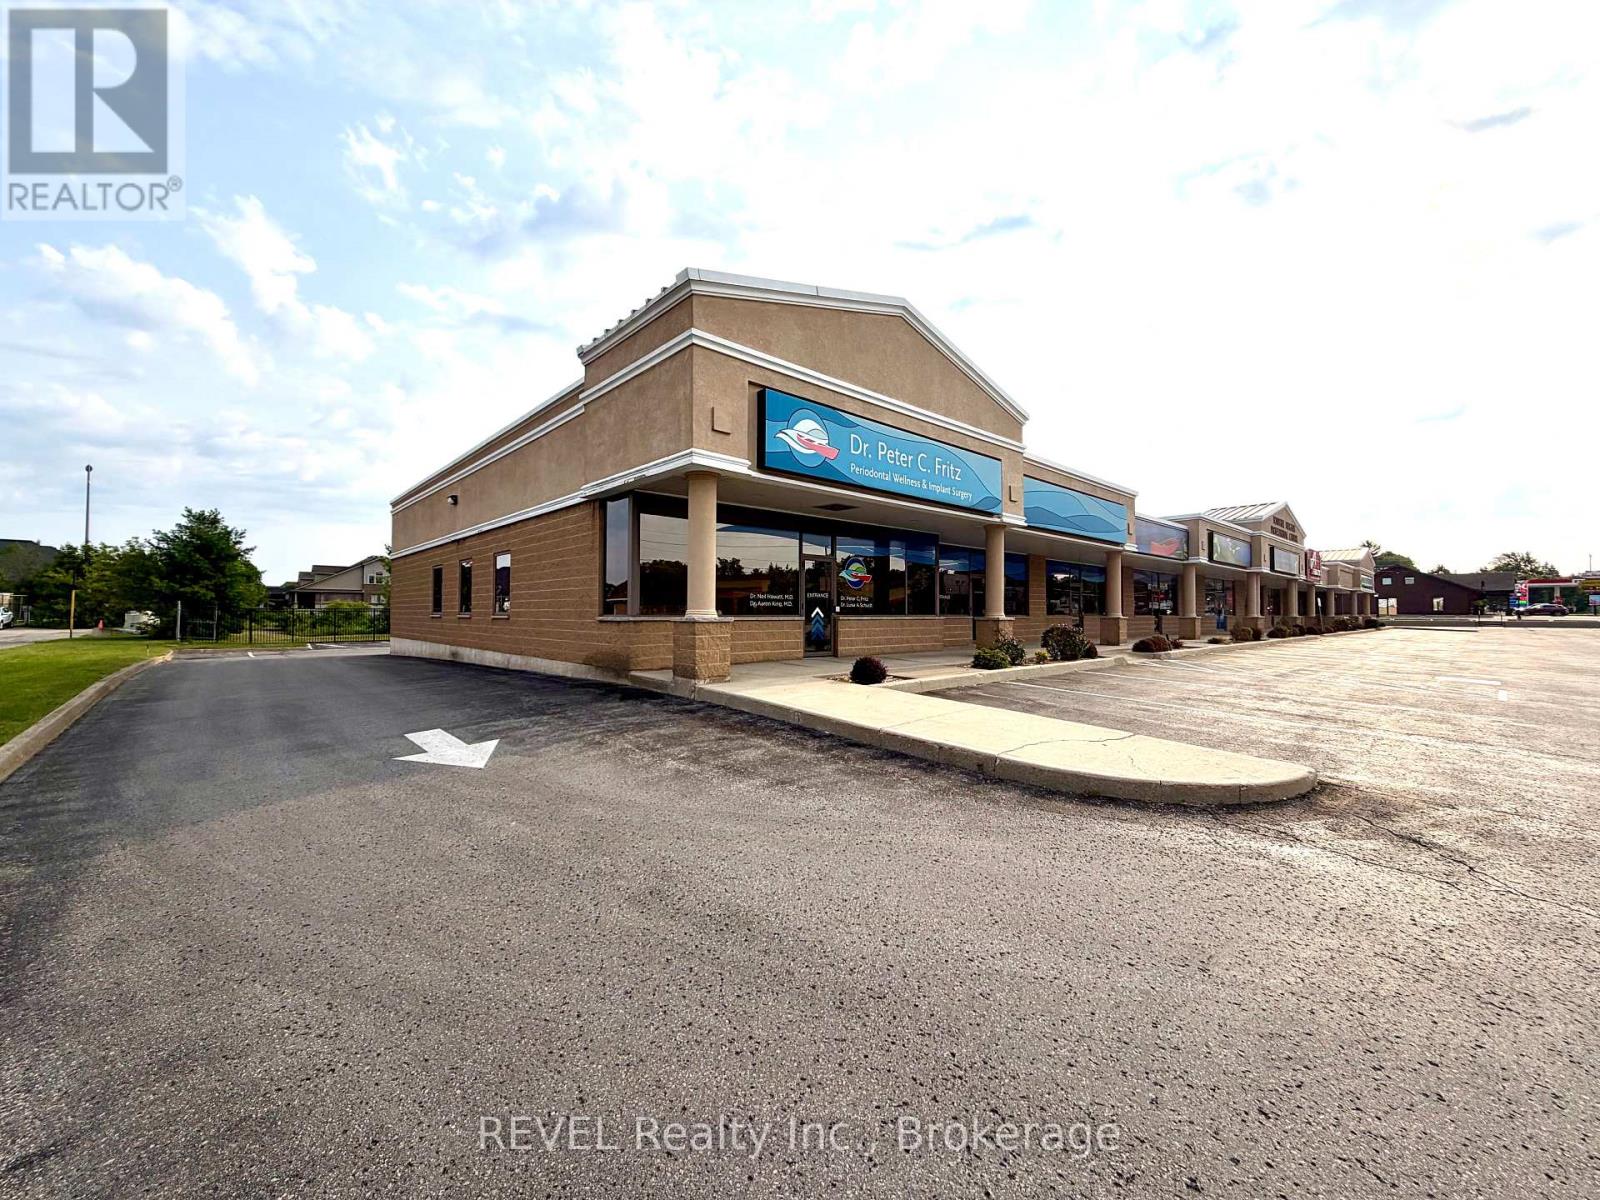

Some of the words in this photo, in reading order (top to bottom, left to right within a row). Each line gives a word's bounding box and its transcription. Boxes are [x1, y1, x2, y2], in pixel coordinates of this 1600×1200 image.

[850, 434, 872, 458] Dr.
[878, 441, 913, 468] Peter
[918, 453, 931, 473] C.
[935, 458, 962, 481] Fritz
[850, 463, 891, 481] Periodontal
[892, 472, 921, 488] Wellness
[922, 479, 928, 489] &
[929, 481, 951, 495] Implant
[952, 487, 973, 501] Surgery
